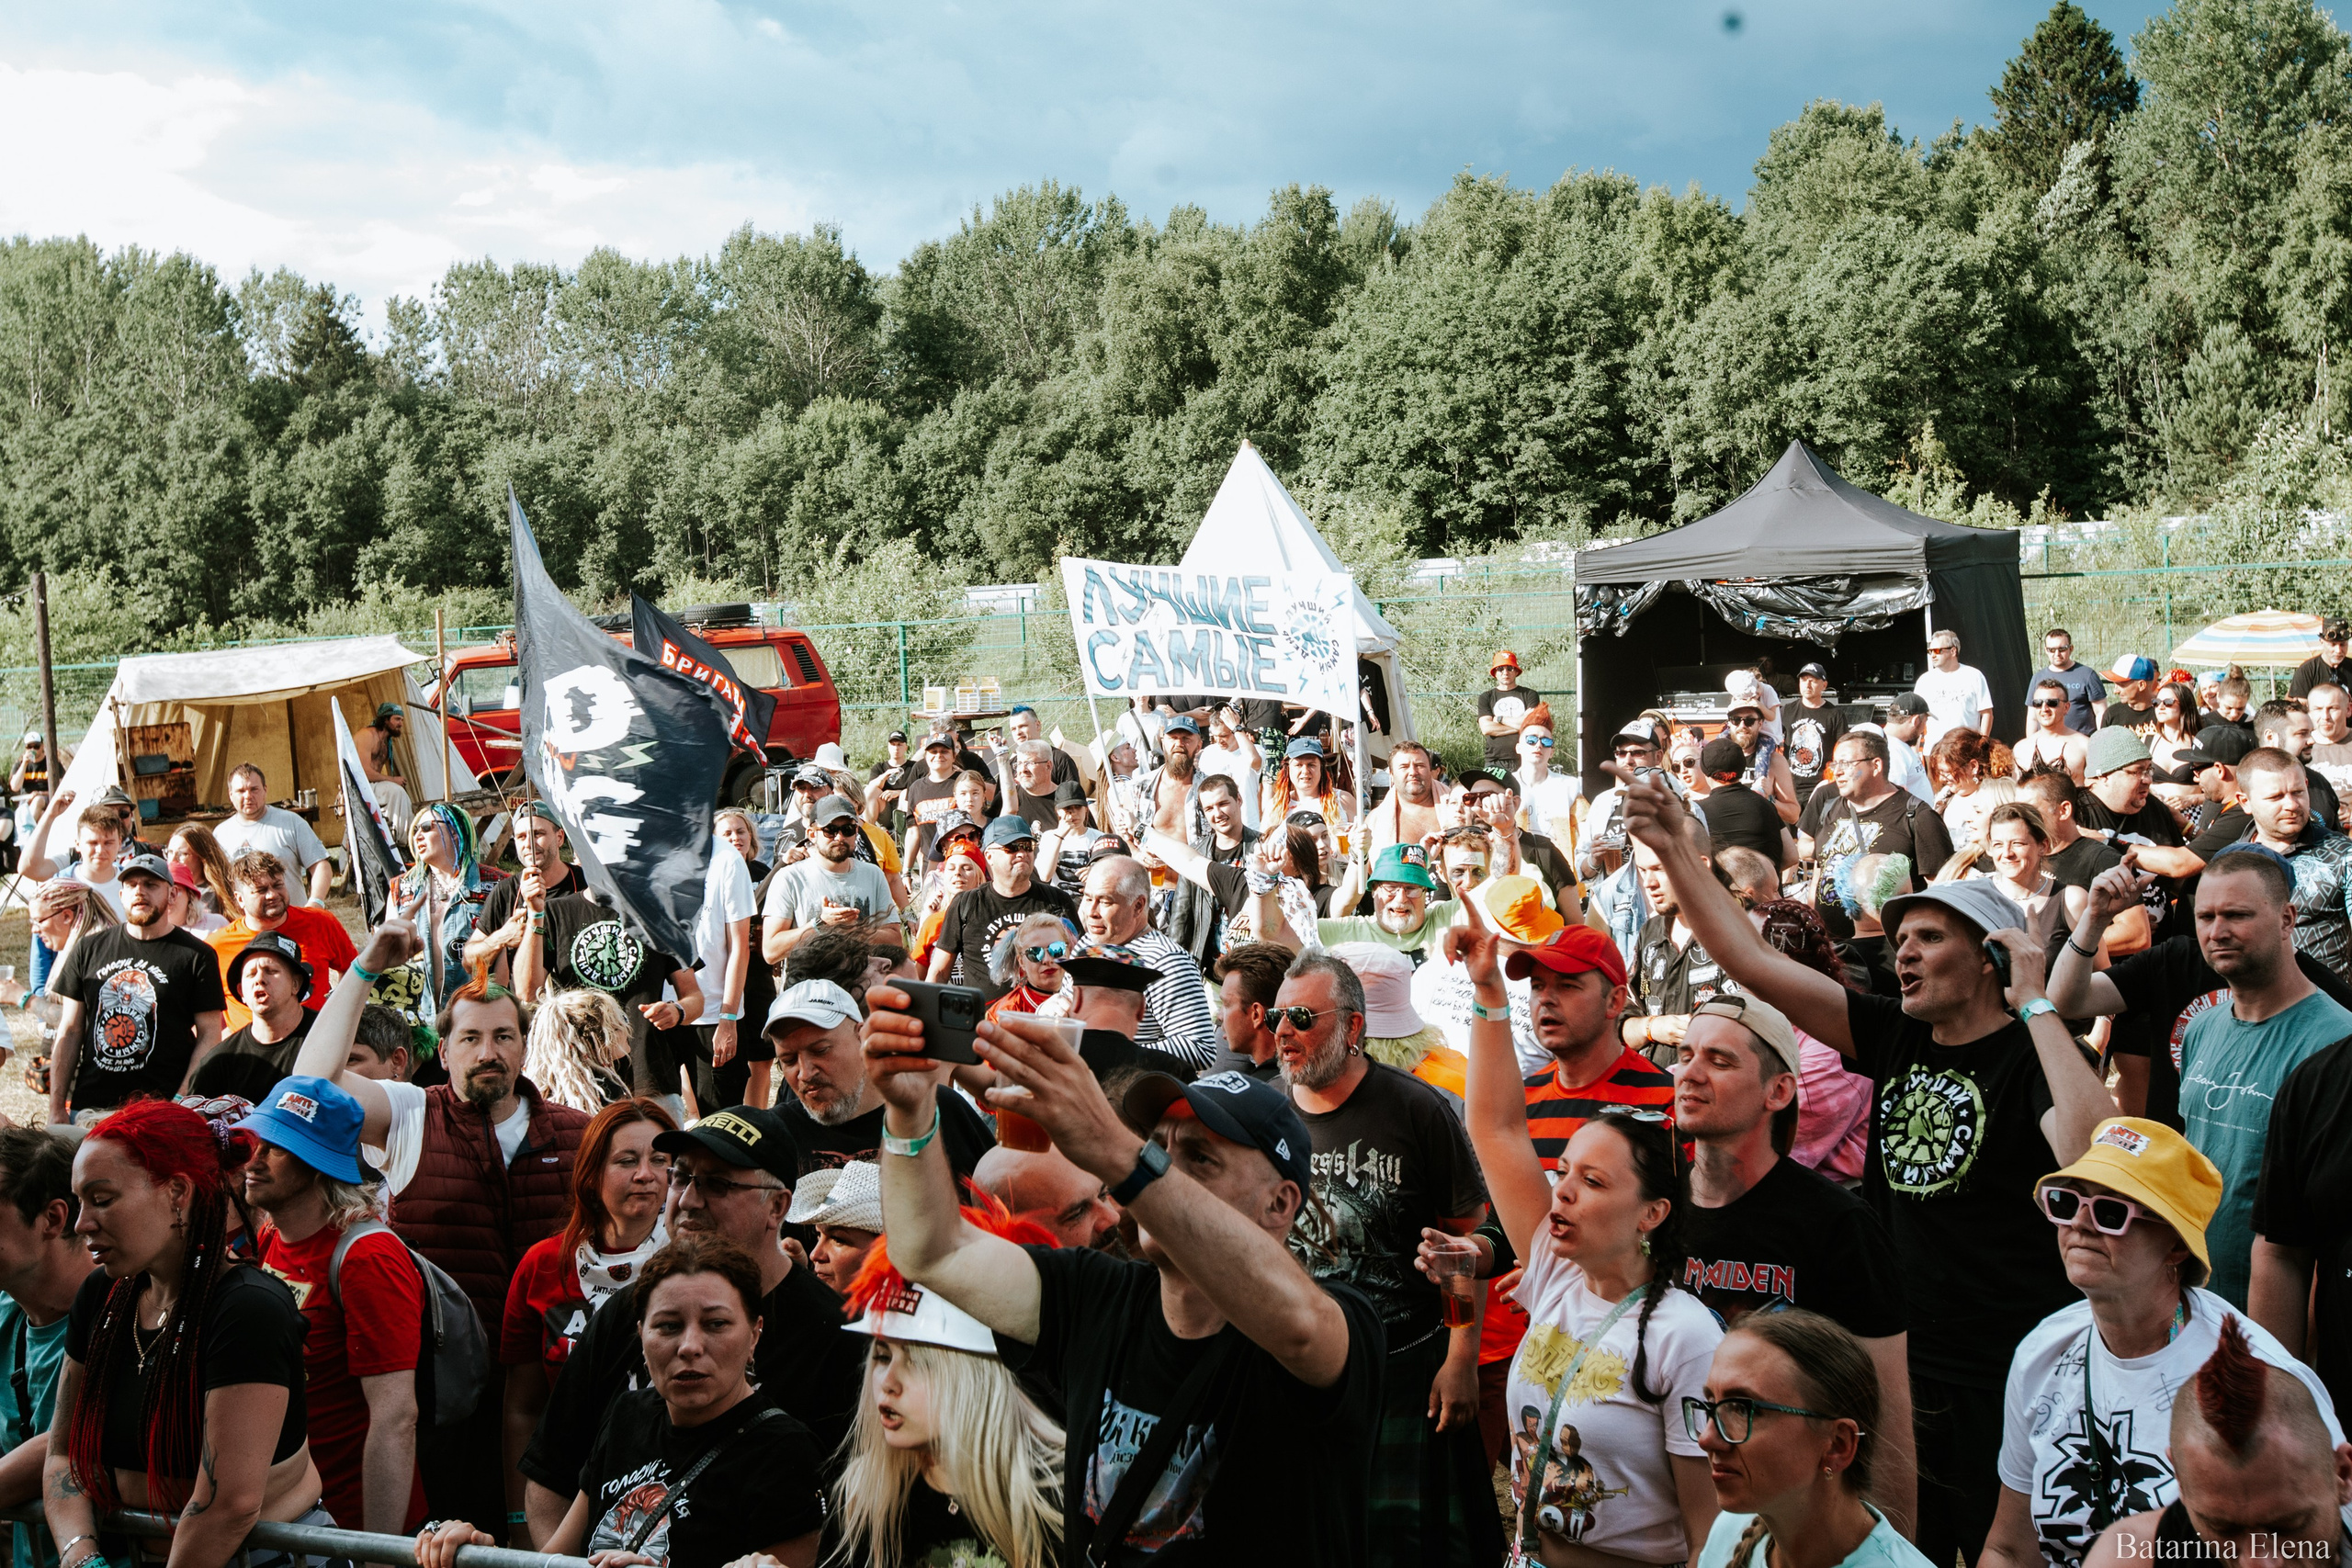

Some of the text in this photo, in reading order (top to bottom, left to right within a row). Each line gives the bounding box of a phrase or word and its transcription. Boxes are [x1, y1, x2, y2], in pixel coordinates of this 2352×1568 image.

[1083, 565, 1278, 635] ЛУЧШИЕ
[1088, 629, 1287, 694] САМЫЕ
[577, 925, 639, 987] ЛУЧШИЙ САМЫЙ ДЕНЬ
[104, 1006, 141, 1022] ЛУЧШИЙ
[116, 1031, 144, 1056] САМЫЙ
[1903, 1125, 1973, 1185] САМЫЙ
[1683, 1257, 1794, 1304] MAIDEN
